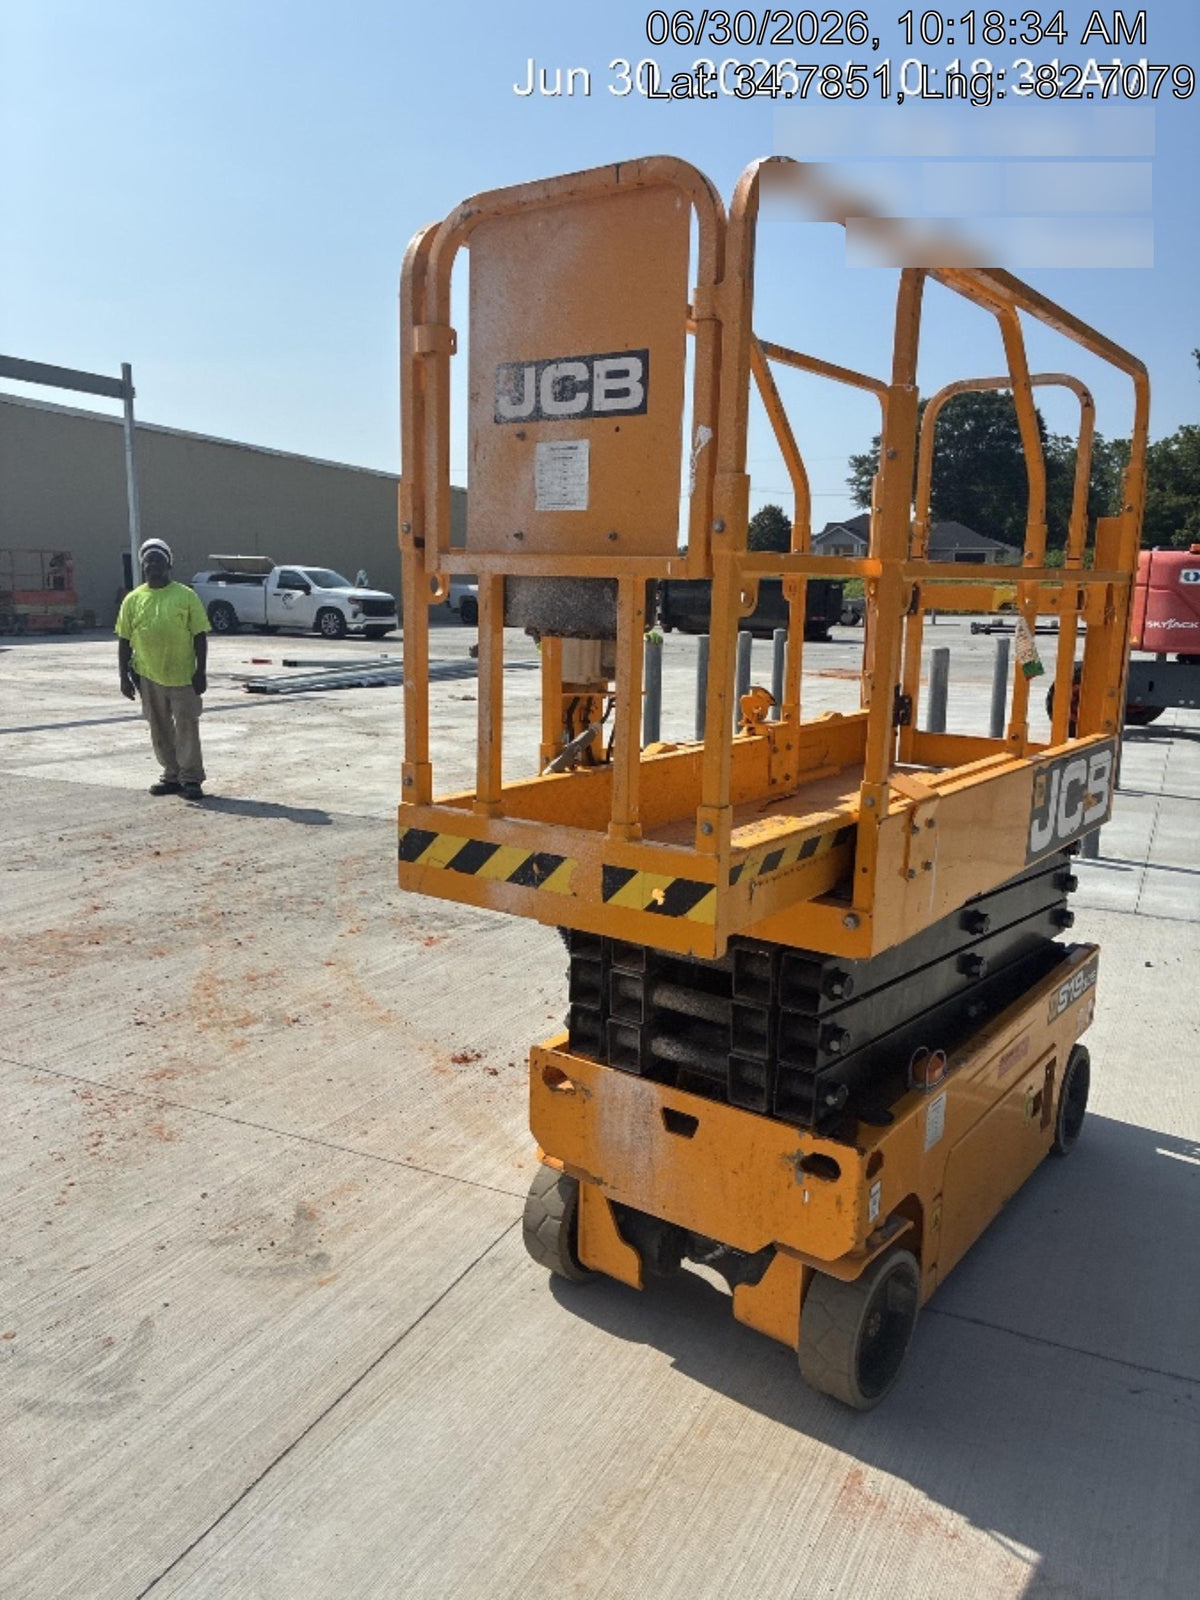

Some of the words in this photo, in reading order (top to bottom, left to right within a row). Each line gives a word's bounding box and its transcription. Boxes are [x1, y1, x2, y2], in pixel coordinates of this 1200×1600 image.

[497, 356, 644, 418] JCB
[1146, 618, 1199, 630] SKYJACK
[1030, 749, 1112, 853] JCB
